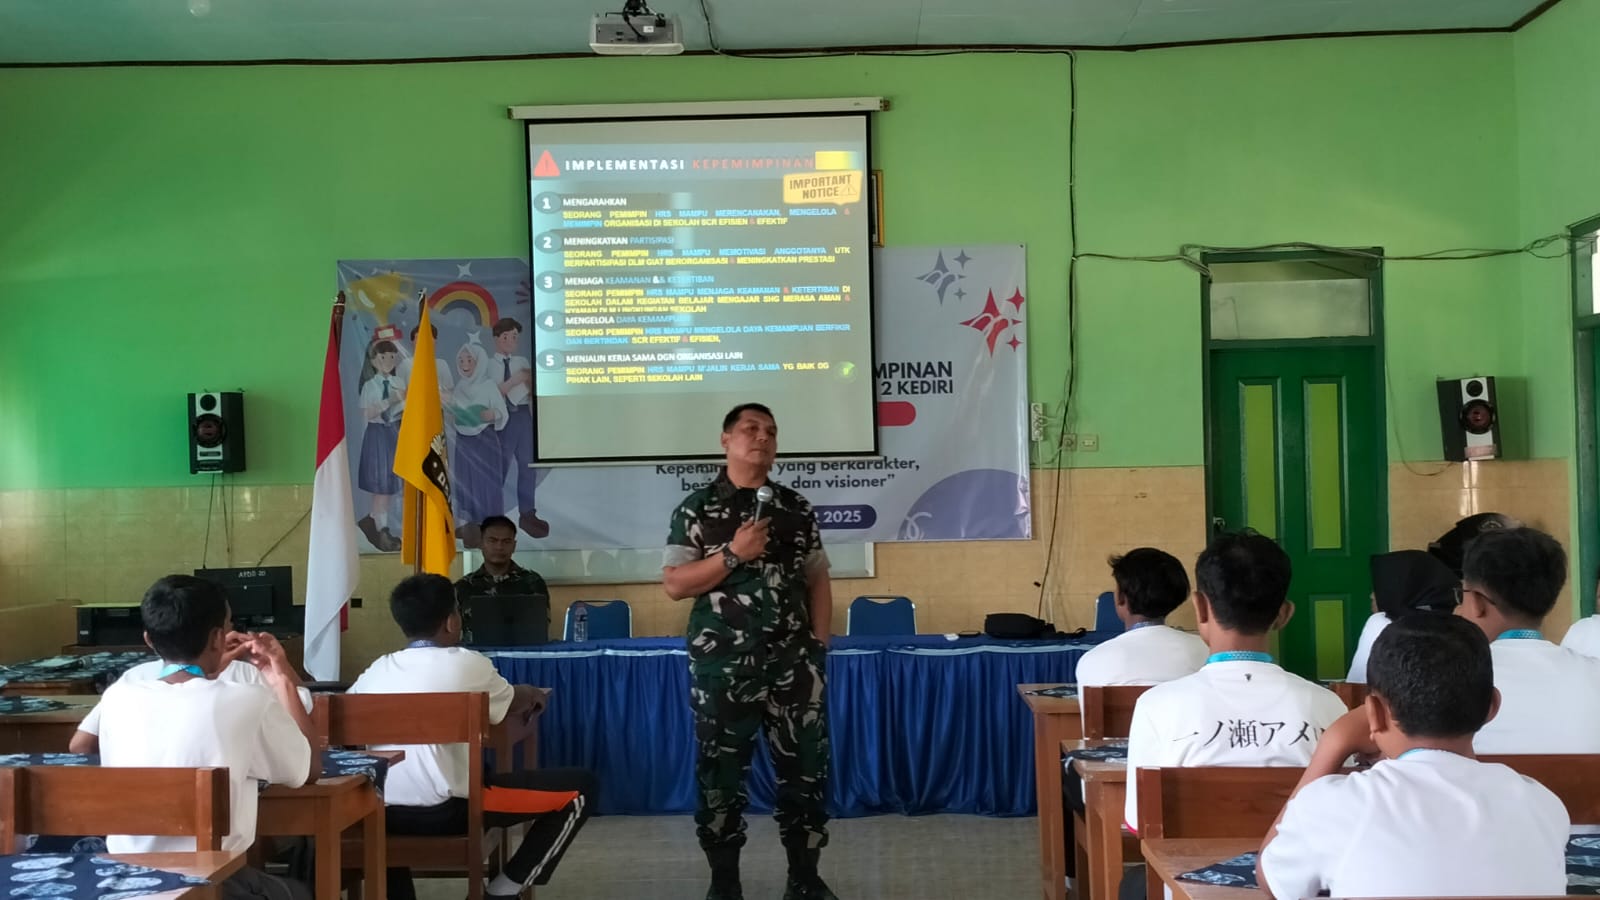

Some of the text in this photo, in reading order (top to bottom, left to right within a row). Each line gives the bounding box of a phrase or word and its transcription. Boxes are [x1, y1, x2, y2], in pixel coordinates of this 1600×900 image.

[566, 159, 813, 171] IMPLEMENTASI KEPEMIMPINAN
[790, 175, 851, 189] IMPORTANT
[803, 187, 839, 199] NOTICE
[543, 198, 627, 209] 1 MENGARAHKAN
[544, 237, 551, 248] 2
[564, 237, 628, 245] MENINGKATKAN
[737, 256, 797, 264] MENINGKATKAN
[799, 255, 835, 263] PRESTASI
[544, 276, 552, 288] 3
[565, 277, 603, 286] MENJAGA
[544, 316, 553, 327] 4
[566, 317, 615, 325] MENGELOLA
[546, 355, 554, 366] 5
[567, 355, 606, 363] MENJALIN
[632, 354, 656, 362] SAMA
[677, 352, 723, 360] ORGANISASI
[797, 362, 815, 370] BAIK
[613, 375, 645, 383] SEPERTI
[881, 380, 953, 395] 2 KEDIRI
[777, 463, 816, 476] yang
[821, 457, 920, 472] berkarakter,
[791, 477, 821, 489] dan
[823, 510, 862, 523] 2025
